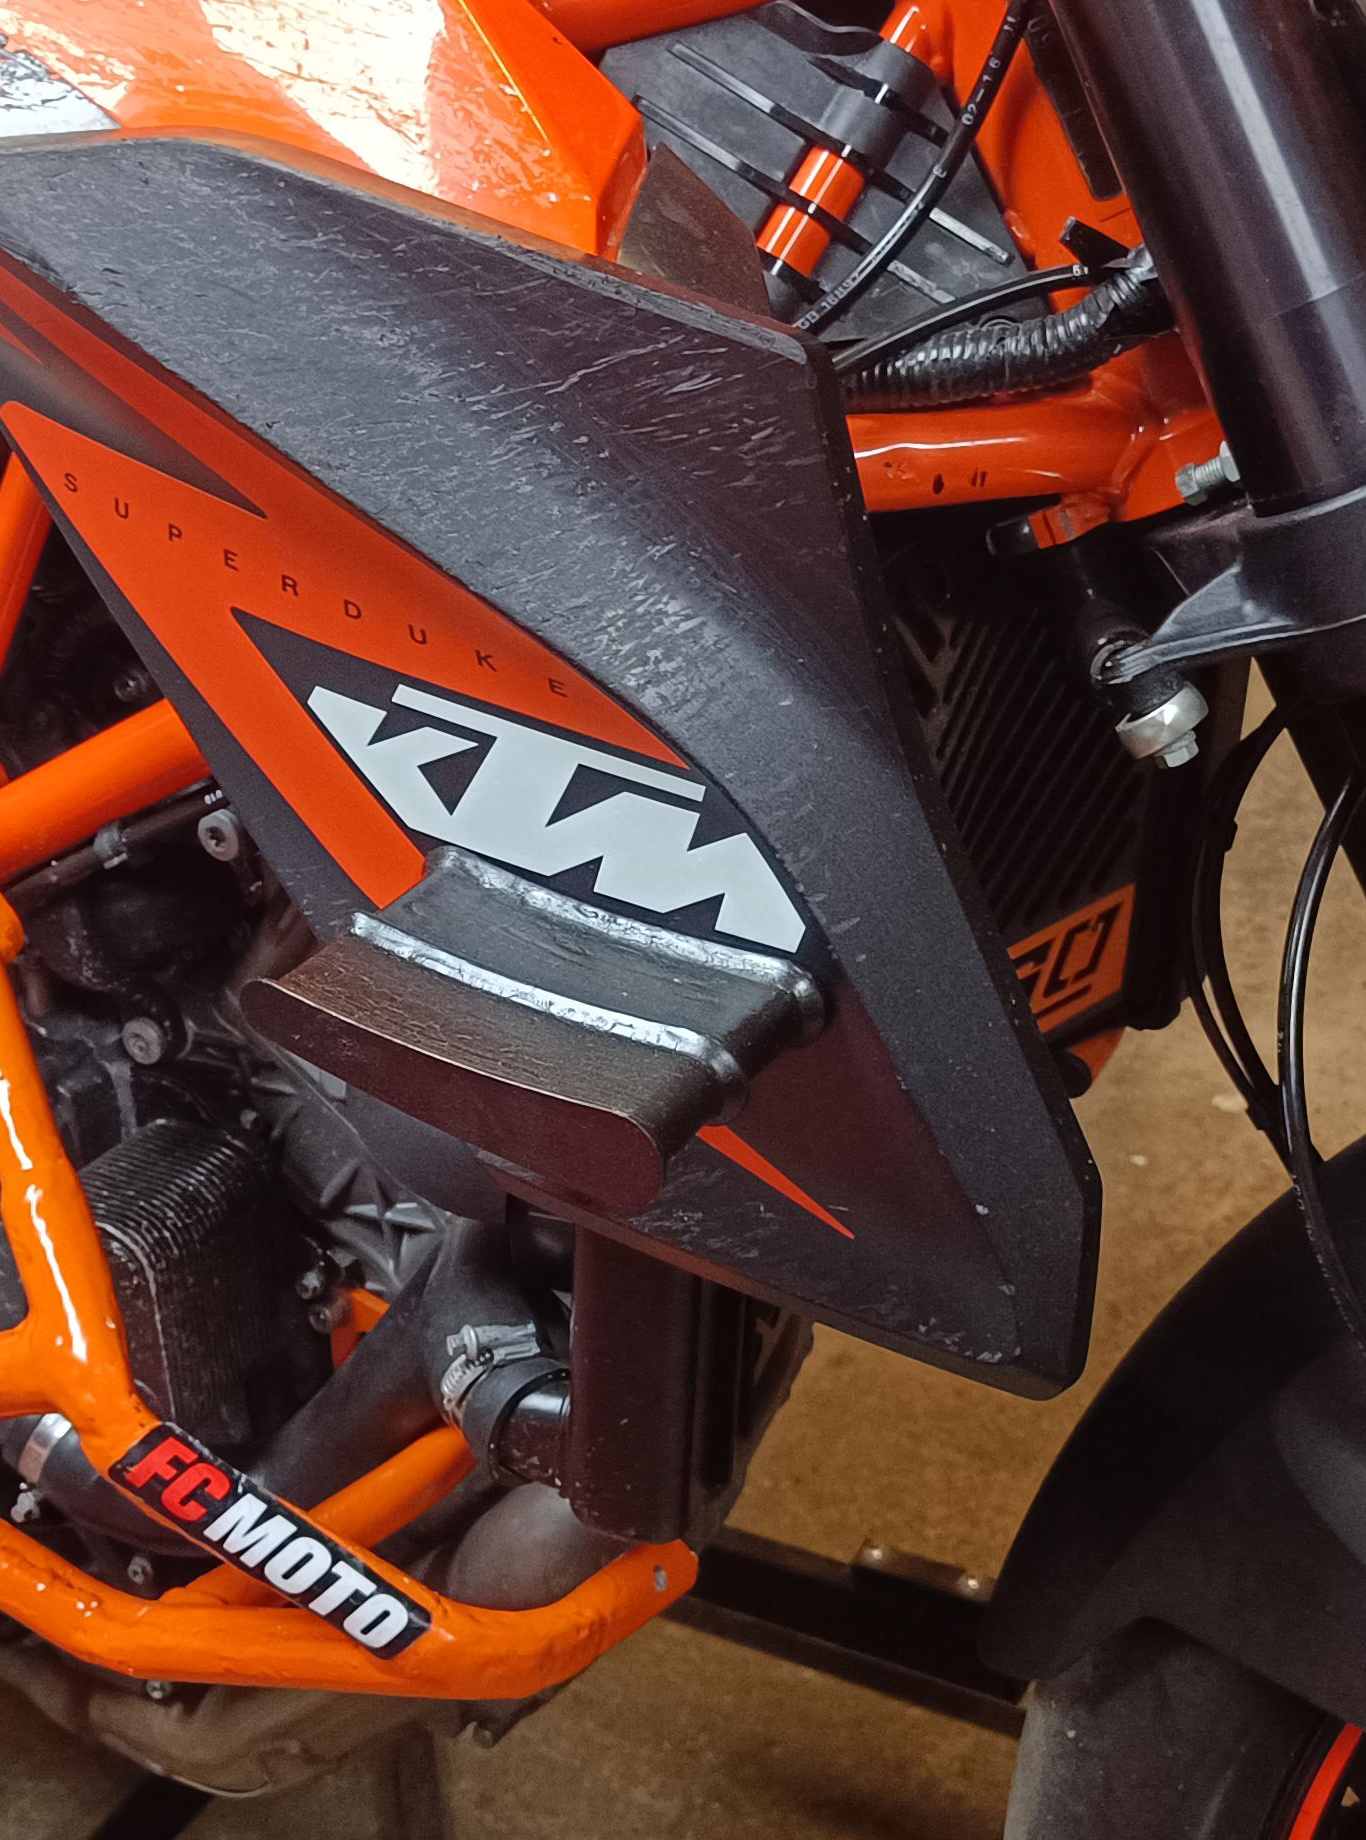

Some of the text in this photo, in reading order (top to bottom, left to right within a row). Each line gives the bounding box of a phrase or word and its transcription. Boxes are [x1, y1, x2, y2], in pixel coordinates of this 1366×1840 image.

[307, 683, 807, 954] KTM
[124, 1435, 410, 1650] FC MOTO
